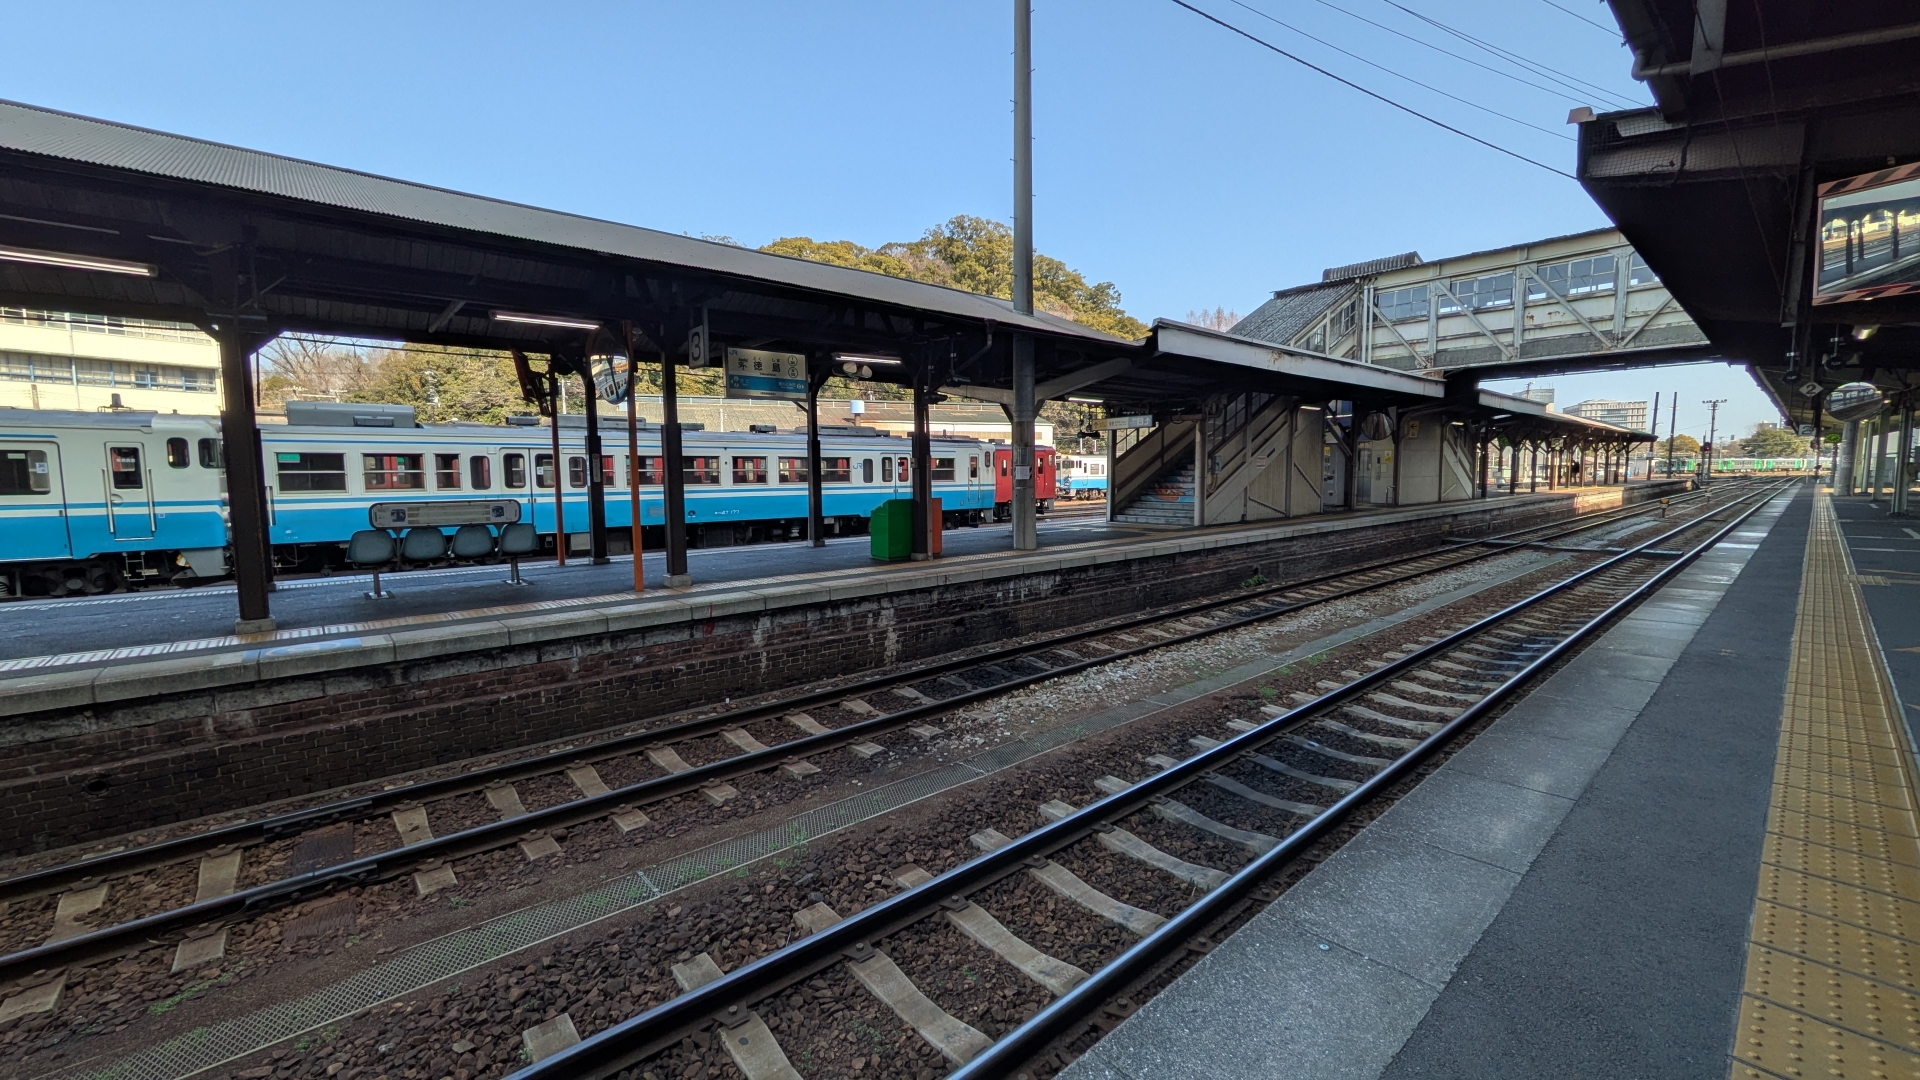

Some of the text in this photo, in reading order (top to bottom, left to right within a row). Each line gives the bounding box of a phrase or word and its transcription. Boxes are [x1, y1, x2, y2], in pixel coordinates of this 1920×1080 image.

[691, 332, 700, 361] 3
[753, 361, 780, 372] 徳島
[1806, 384, 1816, 396] 2
[1801, 425, 1812, 435] 2
